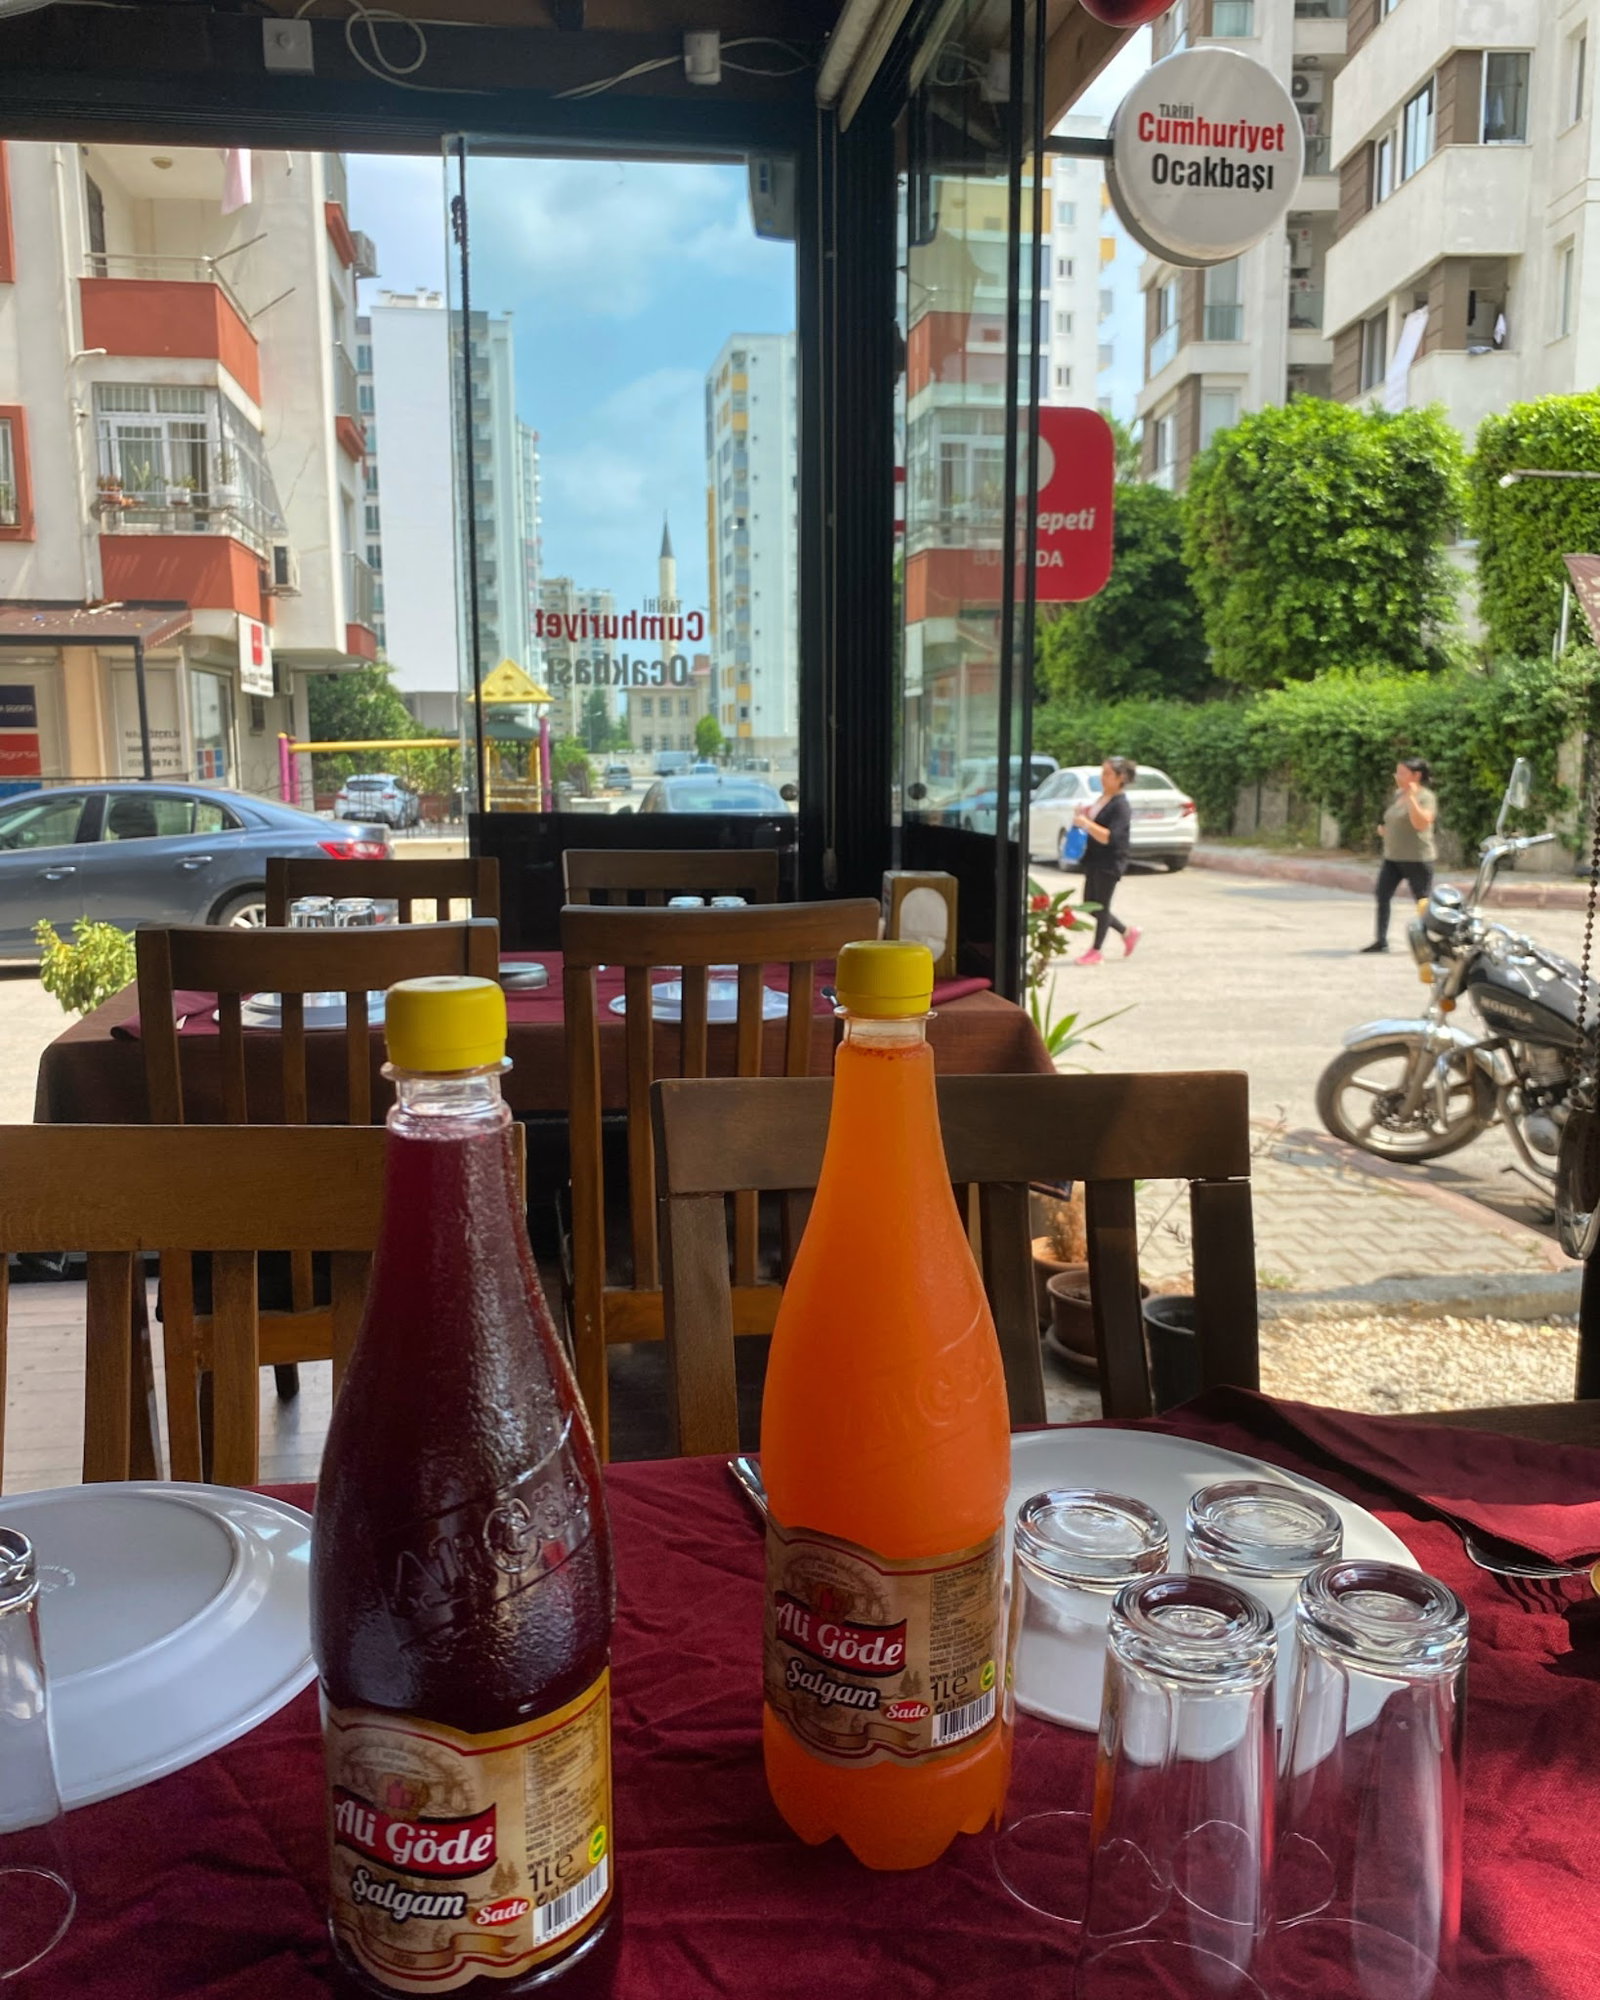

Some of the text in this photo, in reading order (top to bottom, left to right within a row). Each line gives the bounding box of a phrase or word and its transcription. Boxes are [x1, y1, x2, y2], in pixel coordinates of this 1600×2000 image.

[1138, 111, 1285, 154] Cumhuriyet
[1151, 153, 1274, 193] Ocakbaşı
[777, 1602, 810, 1642] Ali
[817, 1623, 903, 1666] Göde
[787, 1659, 878, 1709] Şalgam
[886, 1704, 929, 1719] Sade
[335, 1799, 377, 1848] Ali
[385, 1822, 494, 1866] Göde
[351, 1867, 465, 1921] Şalgam
[475, 1900, 529, 1925] Sade
